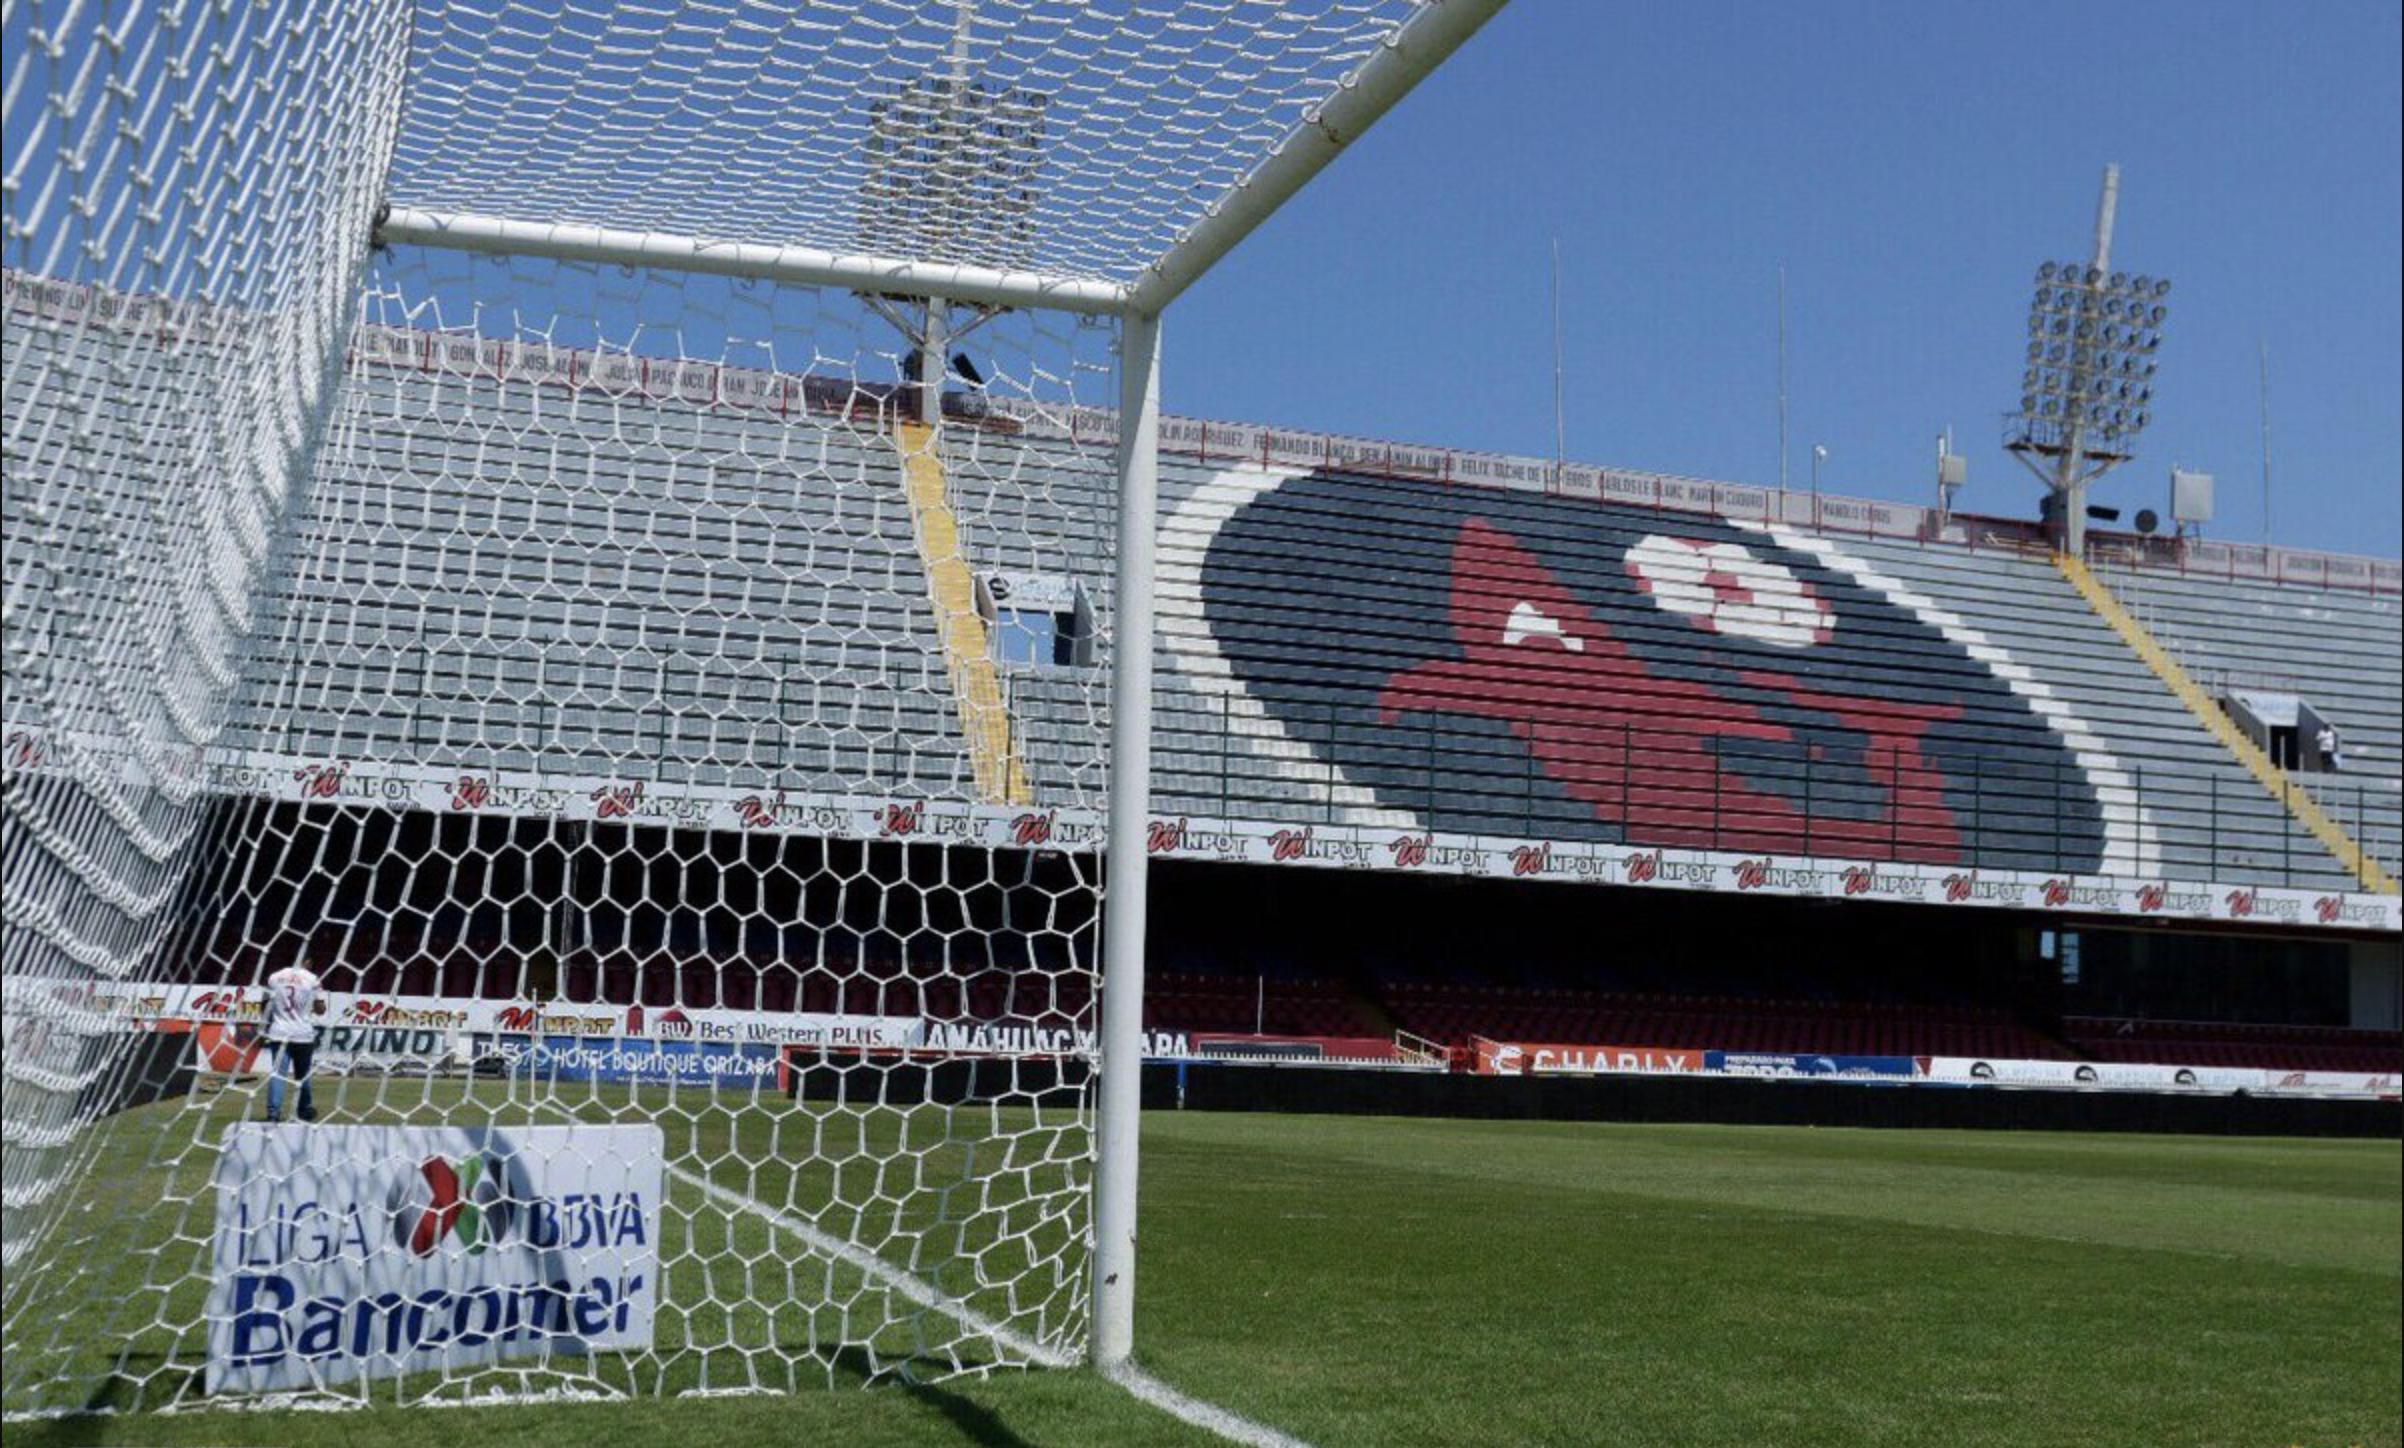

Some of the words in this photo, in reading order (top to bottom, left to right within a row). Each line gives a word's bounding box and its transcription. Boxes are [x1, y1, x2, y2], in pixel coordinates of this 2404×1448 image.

[1148, 818, 1249, 852] WINPOT
[1268, 826, 1374, 861] WINPOT
[1389, 834, 1490, 867] WINPOT
[1508, 842, 1606, 876] WINPOT
[1622, 849, 1716, 884] WINPOT
[1732, 857, 1825, 891] WINPOT
[1839, 861, 1926, 896] WINPOT
[1941, 870, 2026, 903] WINPOT
[2039, 874, 2122, 908] WINPOT
[2136, 881, 2213, 913] WINPOT
[2225, 885, 2301, 918] WINPOT
[2313, 892, 2388, 923] WINPOT
[555, 1047, 607, 1070] HOTEL
[612, 1051, 699, 1077] BOUTIQUE
[238, 1202, 370, 1264] LIGA
[530, 1191, 647, 1249] BBVA
[232, 1274, 643, 1368] Bancomer
